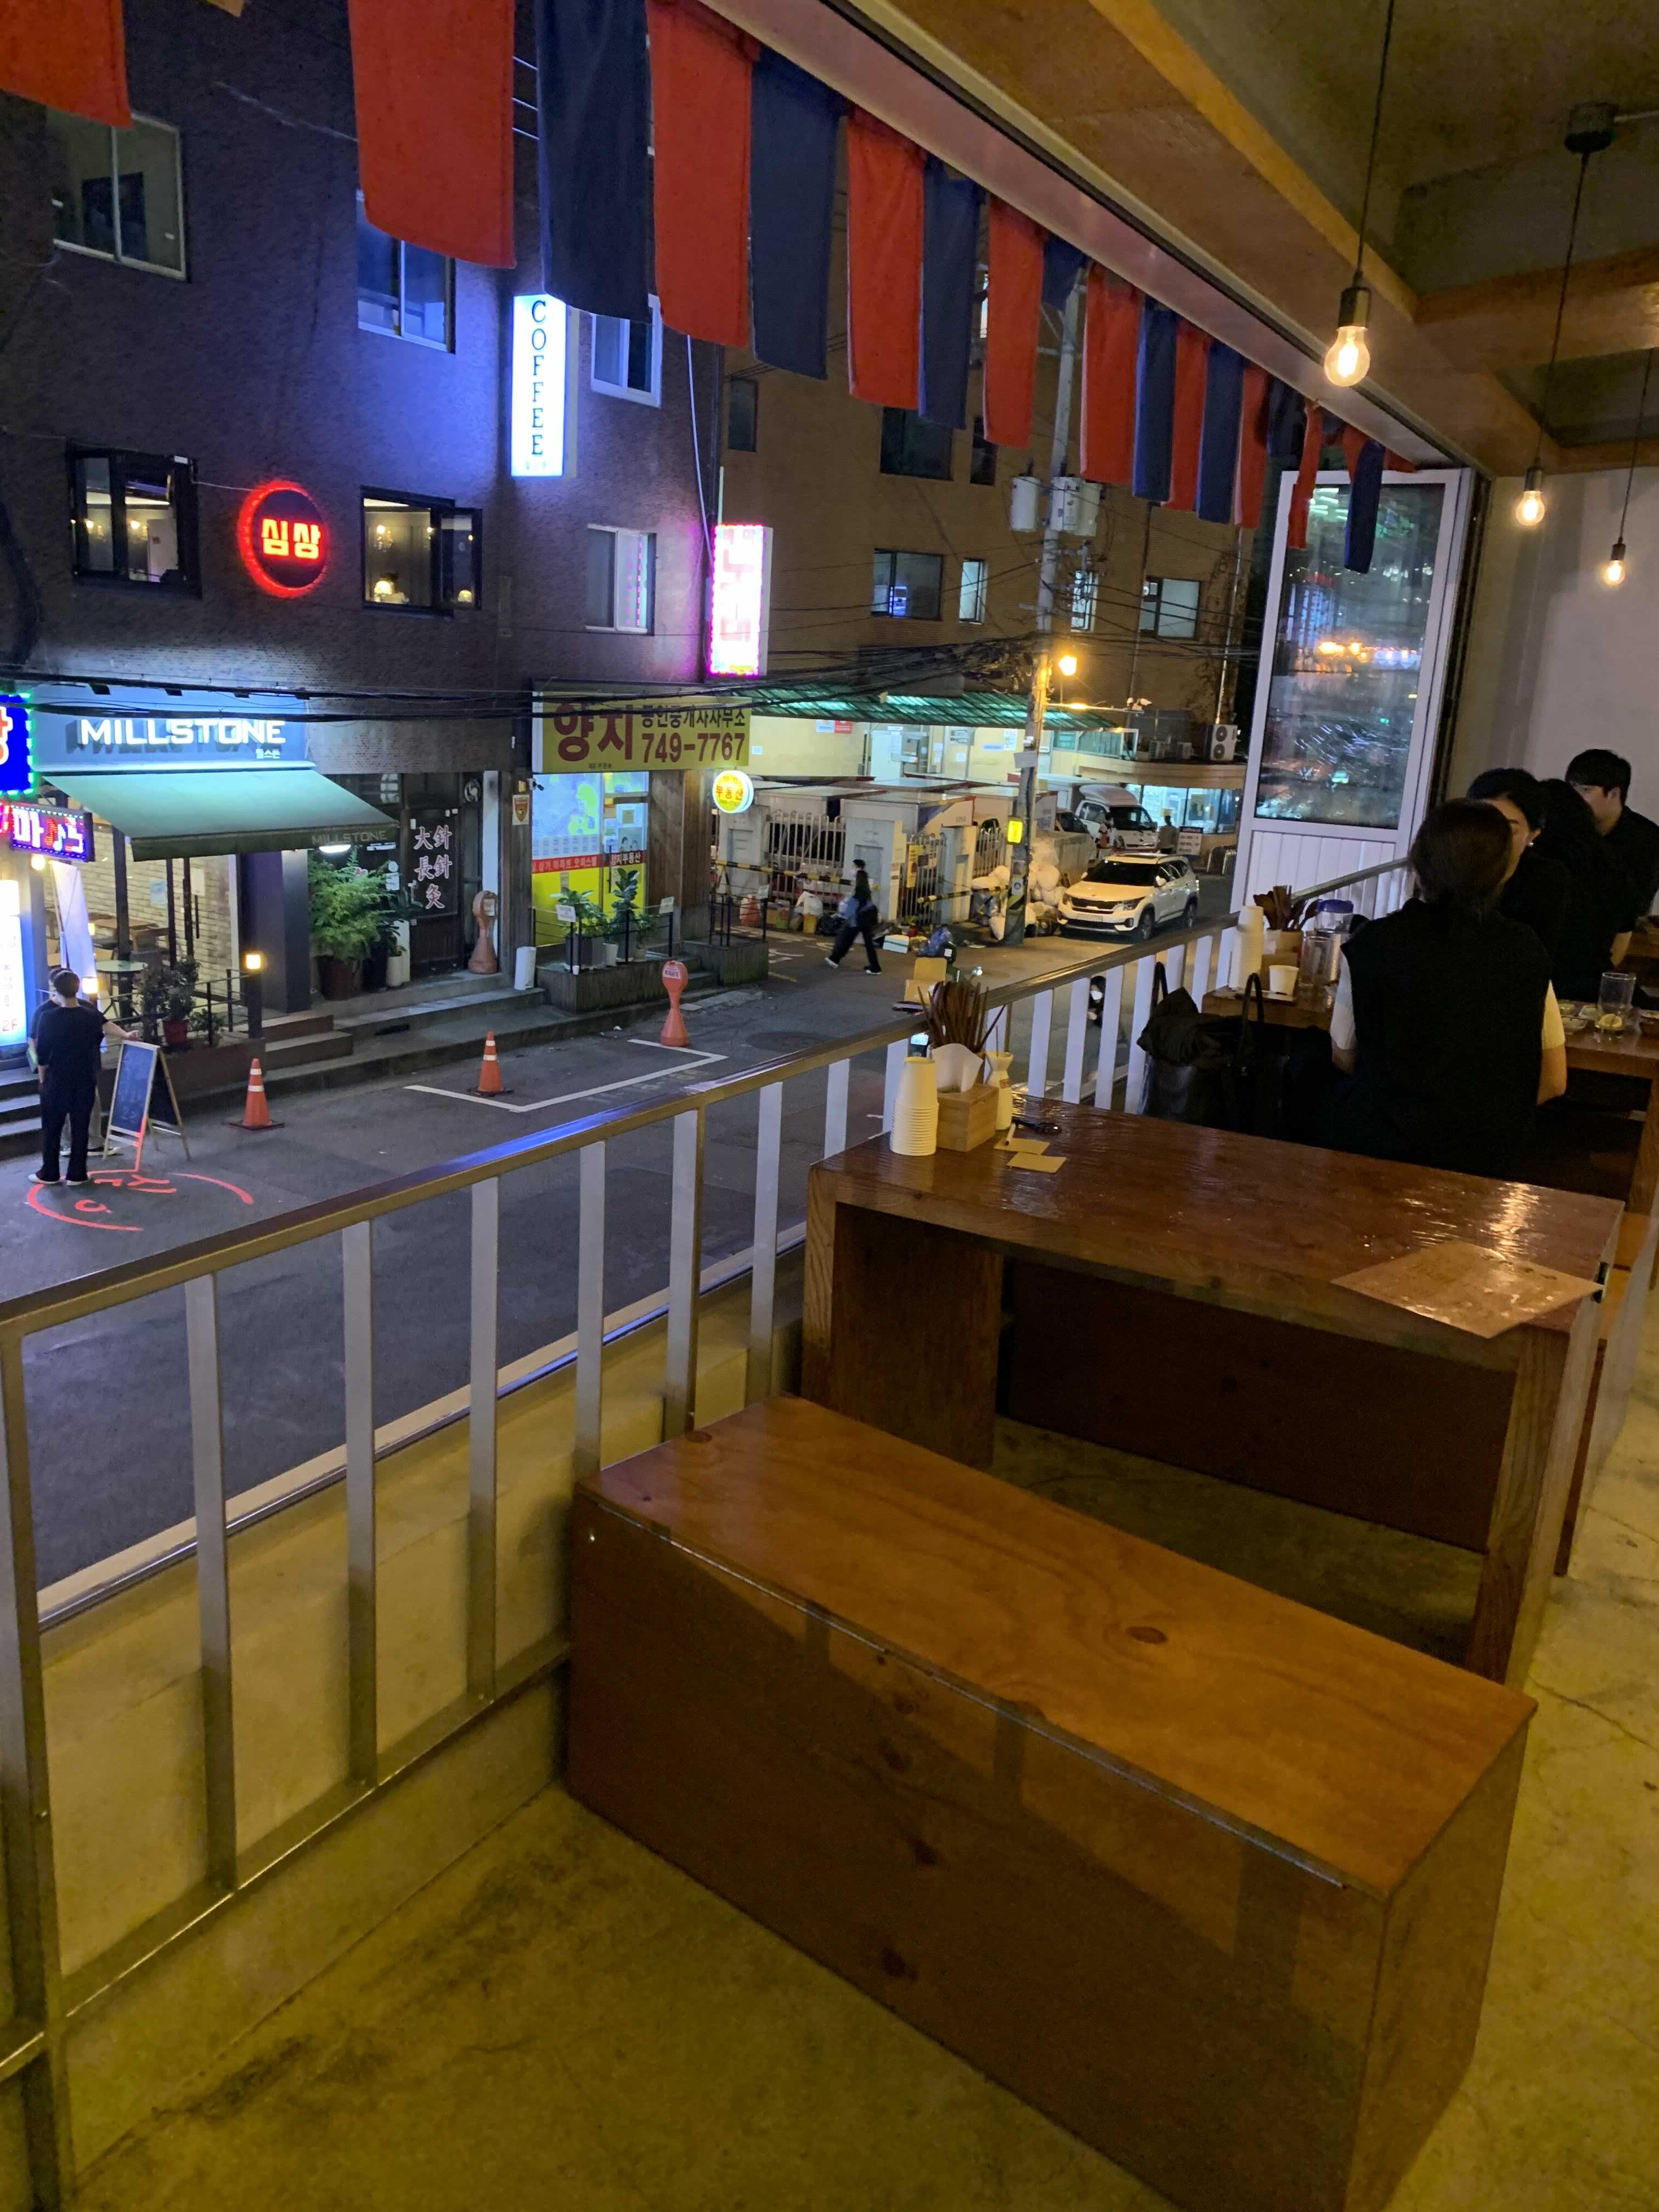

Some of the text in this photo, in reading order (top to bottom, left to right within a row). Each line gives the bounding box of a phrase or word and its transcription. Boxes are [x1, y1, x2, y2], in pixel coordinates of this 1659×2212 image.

[531, 300, 547, 455] COFFEE
[261, 518, 321, 560] 심상
[81, 718, 286, 744] MILLSTONE
[553, 702, 633, 762] 양지
[641, 731, 746, 763] 749-7767
[312, 830, 387, 845] MILLSTONE
[413, 825, 452, 850] 大針
